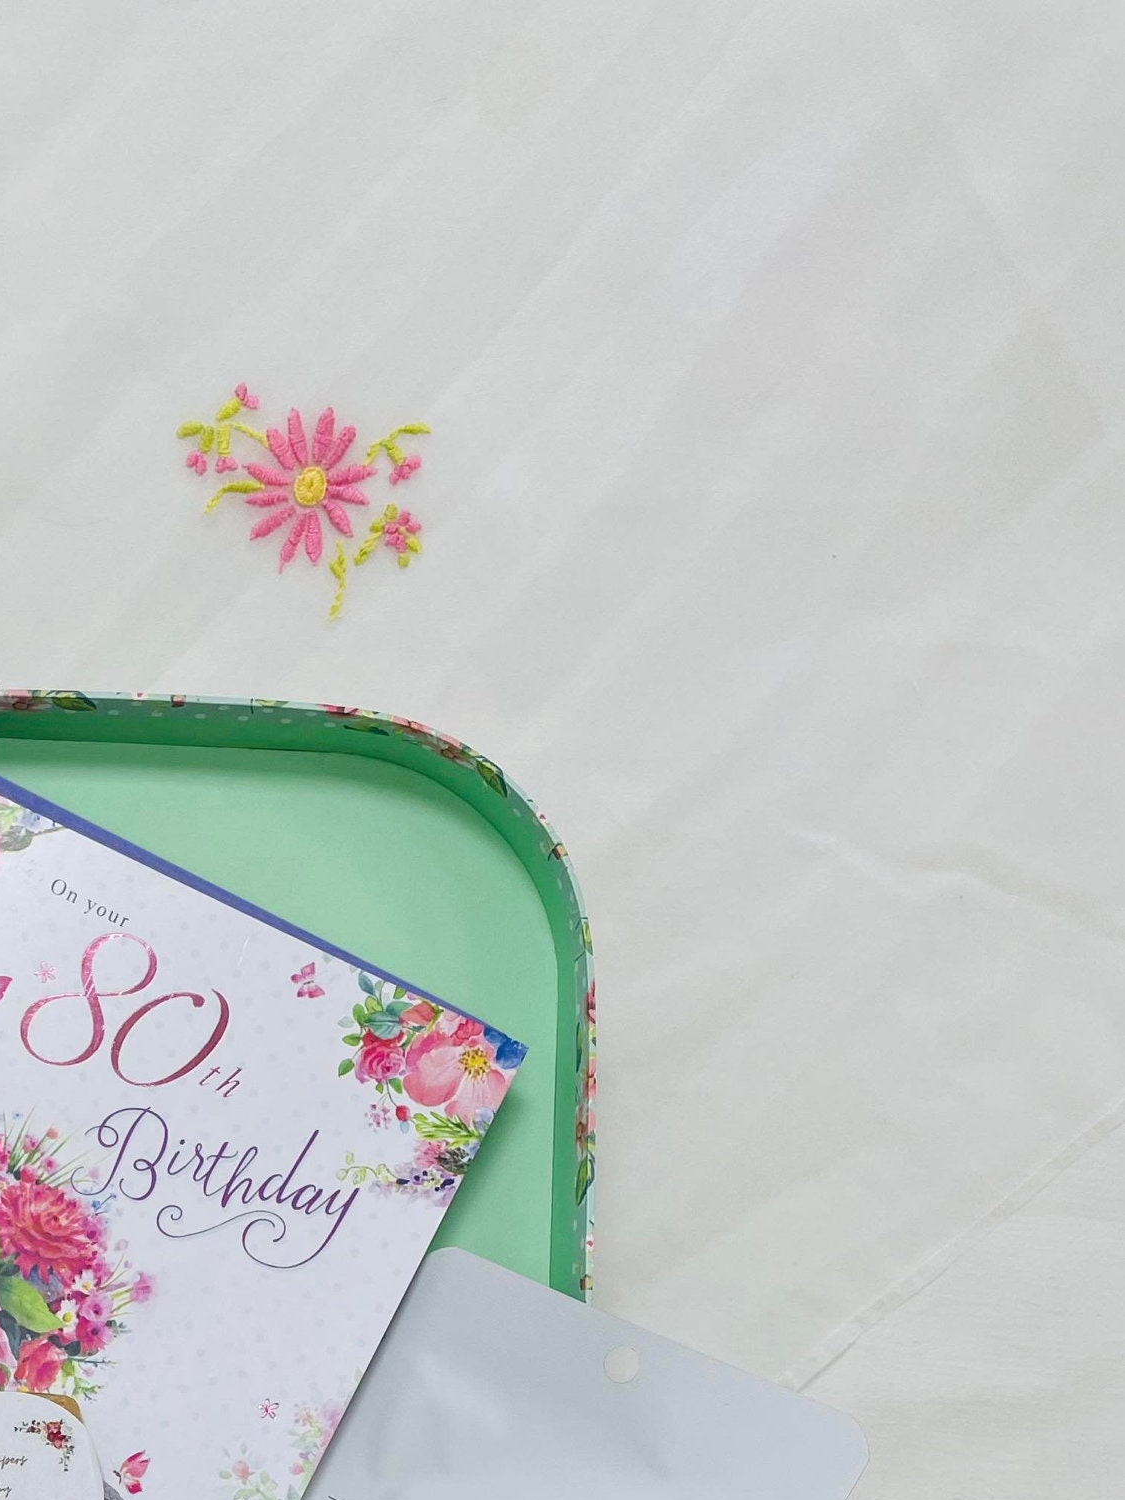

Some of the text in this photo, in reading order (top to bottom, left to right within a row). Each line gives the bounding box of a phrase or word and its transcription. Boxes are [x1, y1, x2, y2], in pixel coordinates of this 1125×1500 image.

[50, 878, 130, 929] On your
[71, 1106, 361, 1269] Birthday
